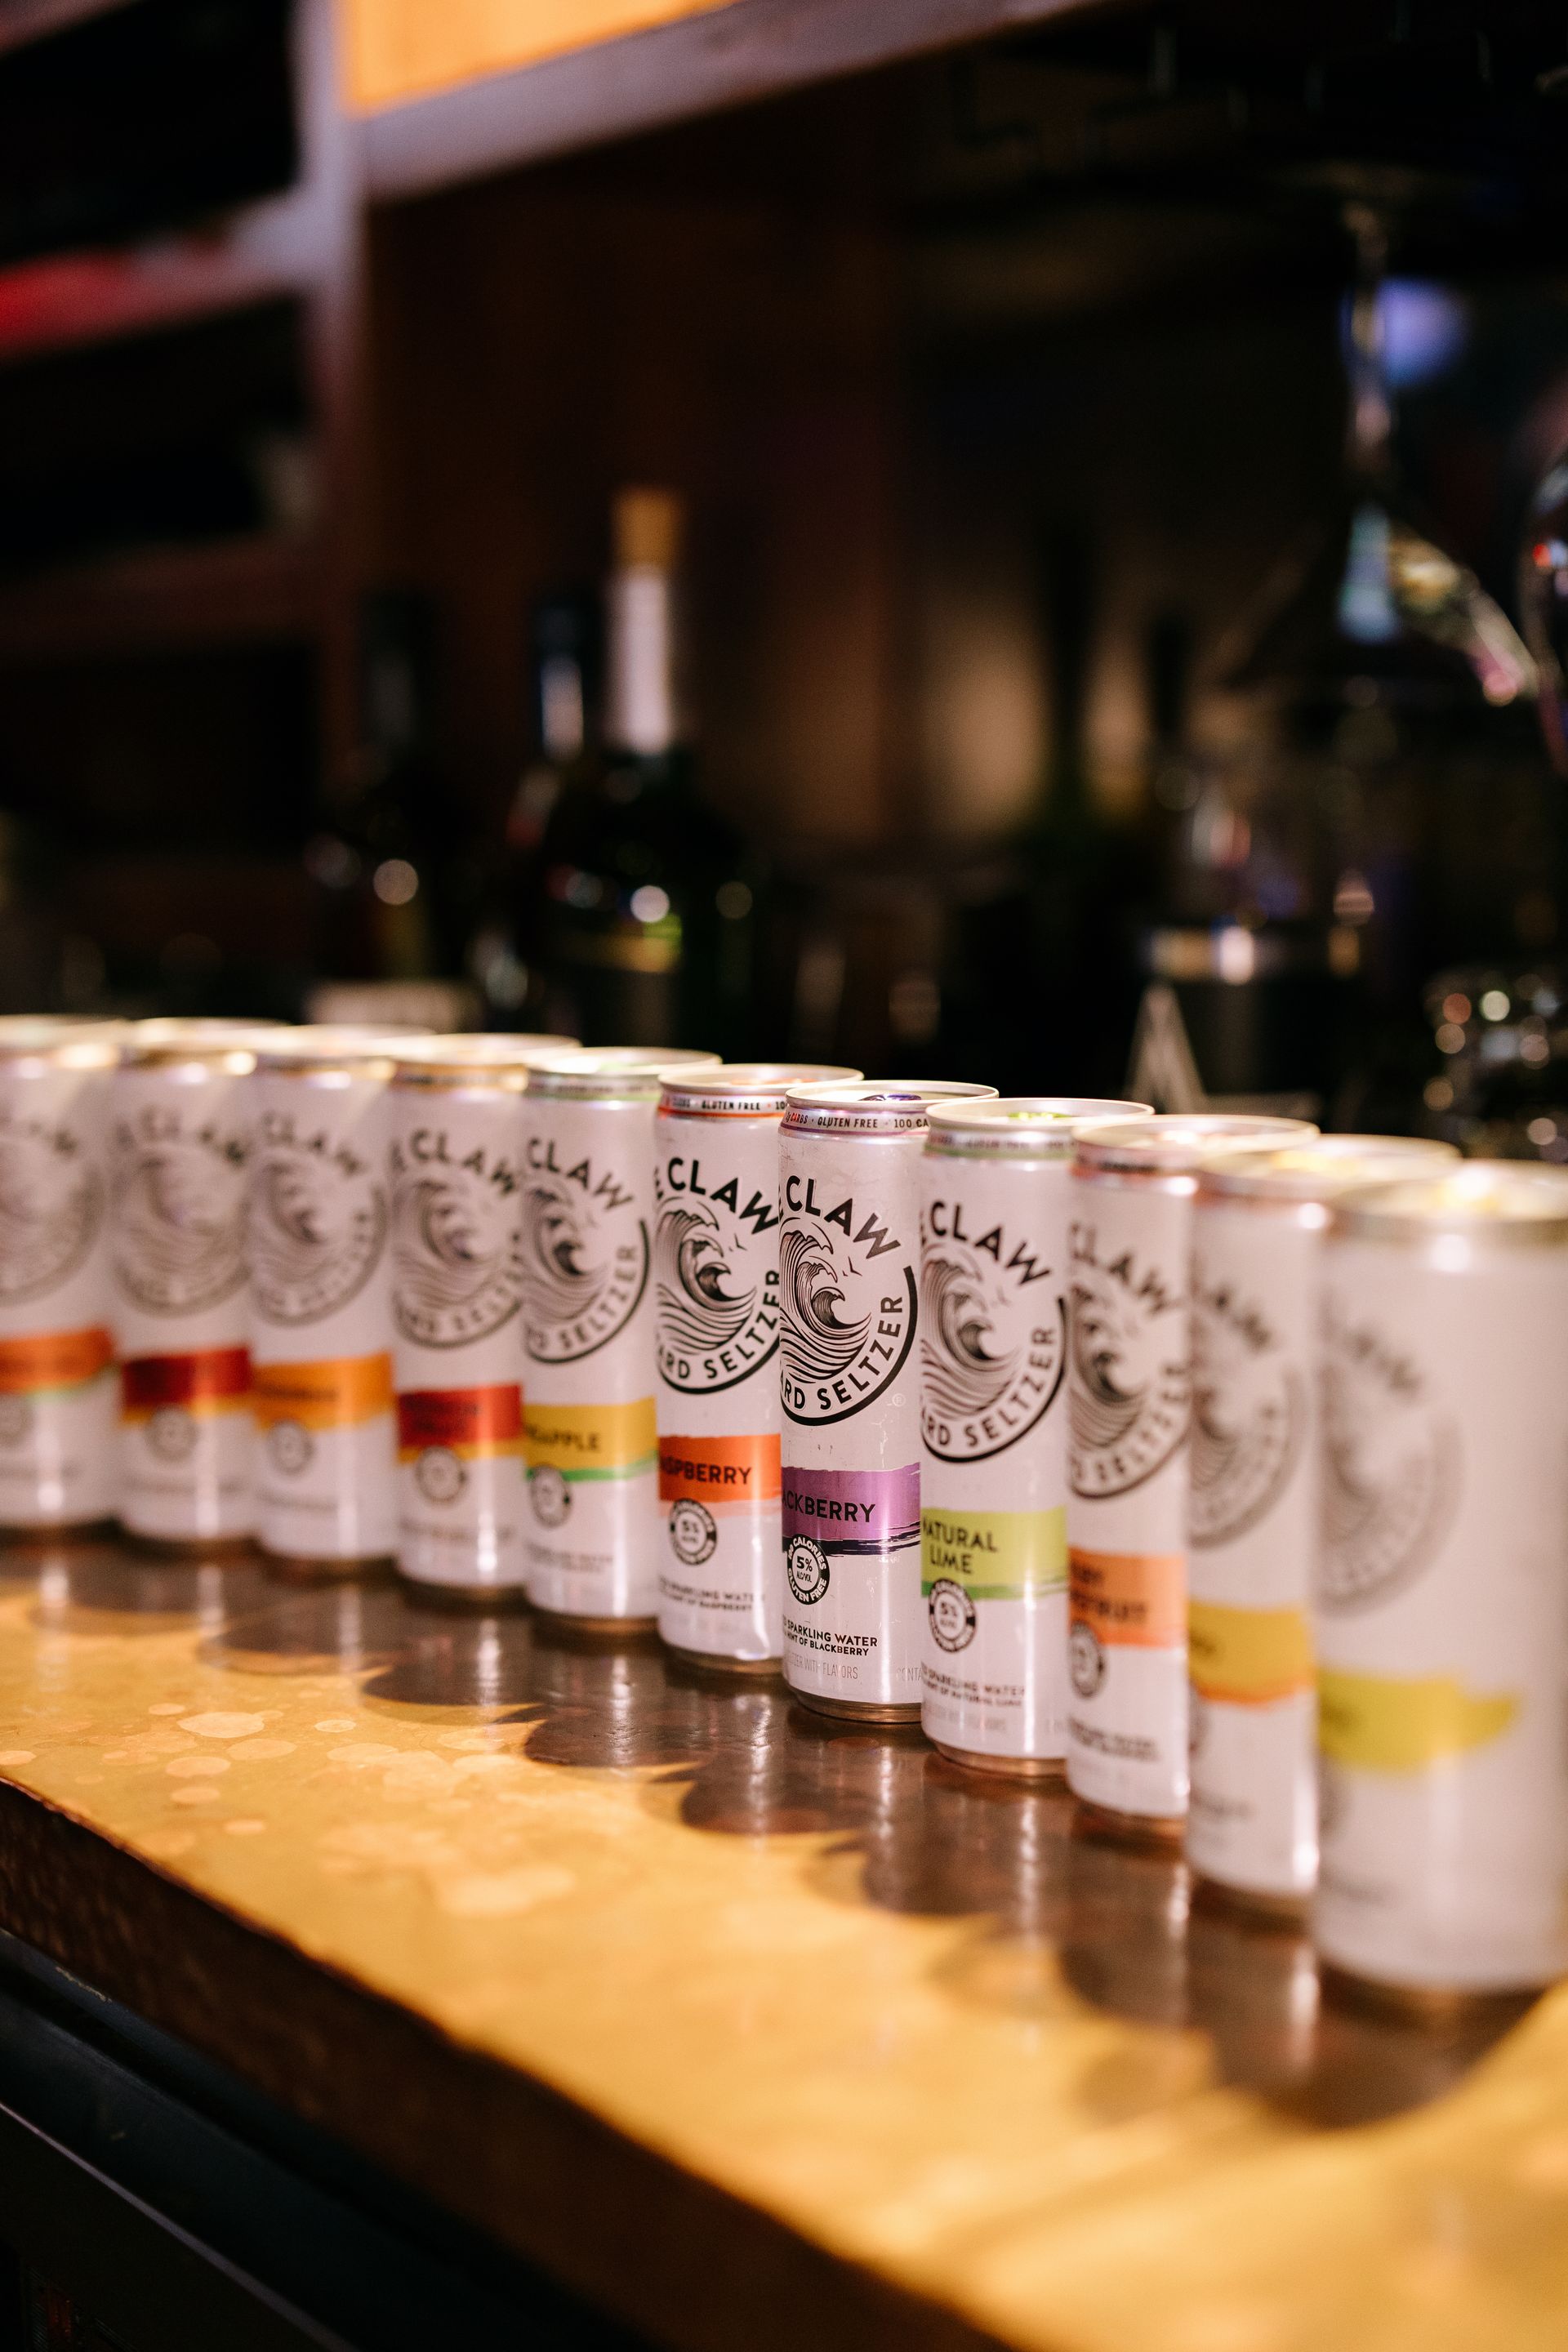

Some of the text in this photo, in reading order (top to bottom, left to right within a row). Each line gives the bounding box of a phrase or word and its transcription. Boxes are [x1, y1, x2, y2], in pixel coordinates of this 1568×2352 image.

[738, 1101, 760, 1111] FREE
[791, 1111, 808, 1125] CARBS
[817, 1116, 850, 1128] GLUTEN
[853, 1119, 878, 1128] FREE
[894, 1119, 912, 1128] 100
[527, 1138, 635, 1211] CLAW
[667, 1157, 781, 1235] CLAW
[786, 1175, 901, 1259] CLAW
[930, 1201, 1051, 1286] CLAW
[703, 1270, 780, 1379] SELTZER
[781, 1297, 902, 1410] RD SELTZER
[964, 1327, 1055, 1446] SELTZER
[793, 1536, 827, 1570] CALORIES
[796, 1556, 813, 1572] 5%
[929, 1546, 973, 1574] LIME
[788, 1566, 827, 1602] GLUTEN FREE
[787, 1619, 831, 1642] SPARKLING
[834, 1633, 878, 1647] WATER
[799, 1637, 808, 1646] OF
[809, 1641, 869, 1656] BLACKBERRY
[822, 1662, 858, 1680] FLAVORS
